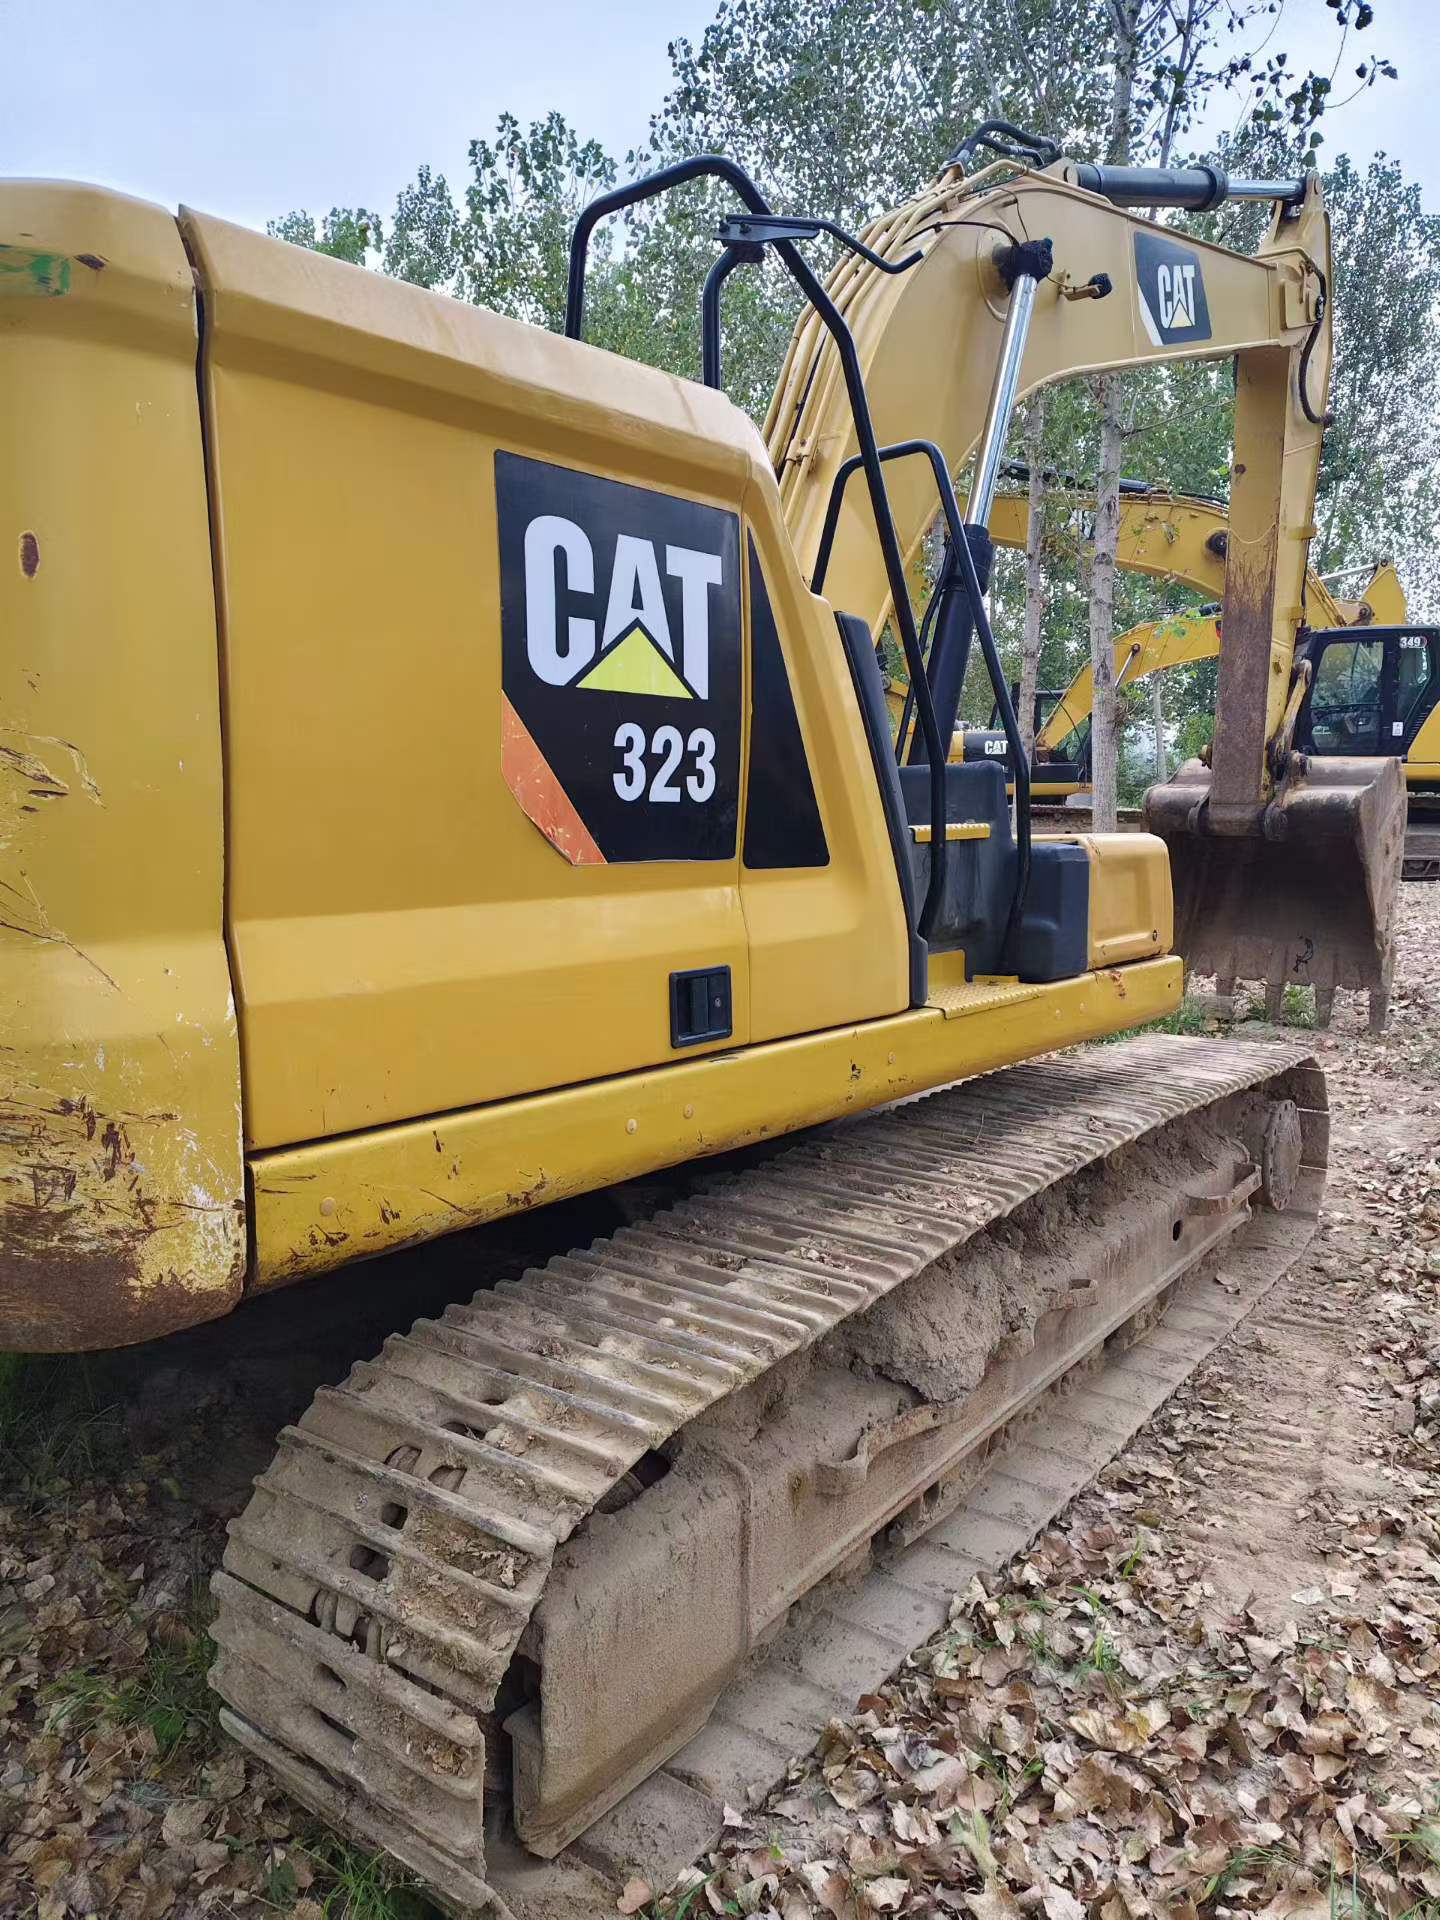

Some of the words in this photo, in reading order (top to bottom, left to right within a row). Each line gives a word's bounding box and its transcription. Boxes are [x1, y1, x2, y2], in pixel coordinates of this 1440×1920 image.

[1157, 264, 1195, 328] CAT
[524, 515, 722, 700] CAT
[612, 722, 716, 802] 323
[984, 740, 1008, 755] CAT
